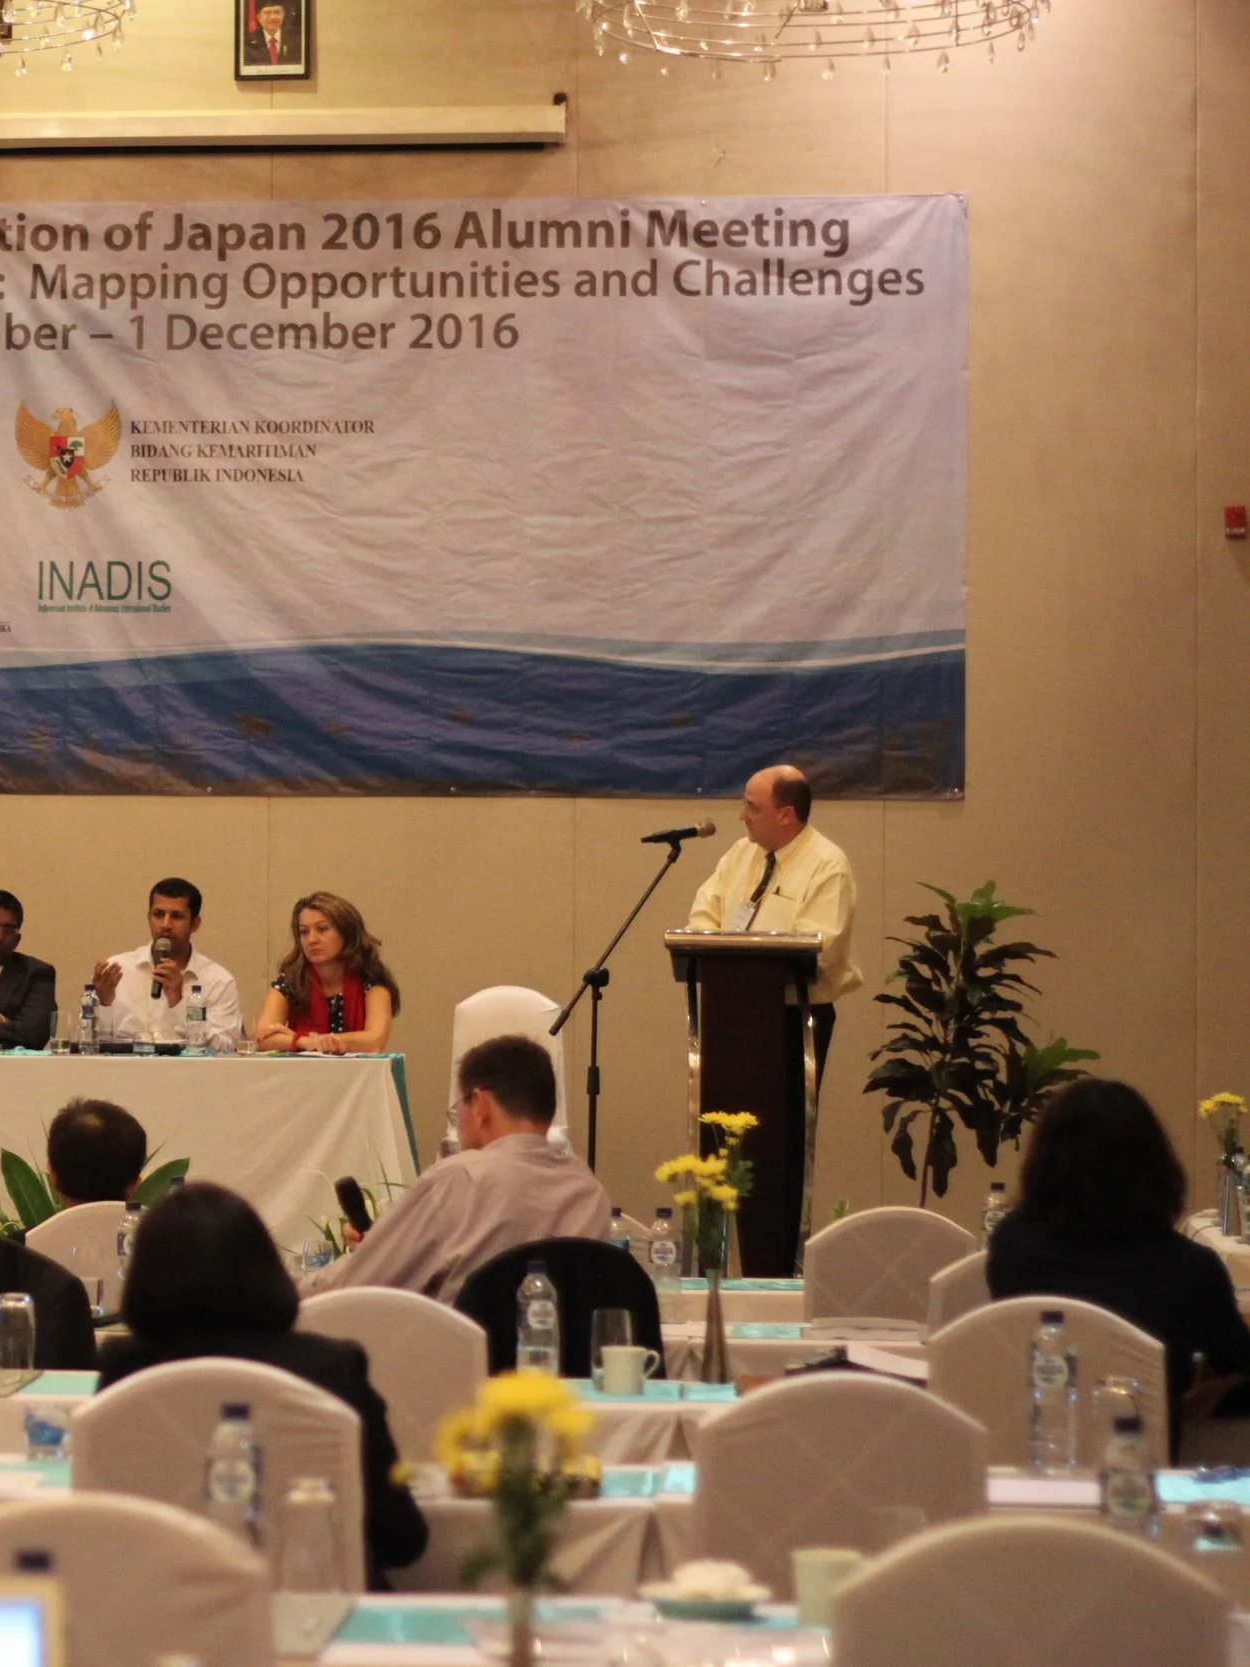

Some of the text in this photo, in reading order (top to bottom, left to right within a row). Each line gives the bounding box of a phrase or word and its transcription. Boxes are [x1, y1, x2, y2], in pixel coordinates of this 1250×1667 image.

[103, 211, 153, 251] of
[164, 213, 305, 261] Japan
[322, 212, 441, 250] 2016
[454, 209, 631, 249] Alumni
[646, 208, 849, 258] Meeting
[30, 263, 227, 309] Mapping
[243, 261, 560, 308] Opportunities
[574, 258, 657, 297] and
[673, 256, 925, 306] Challenges
[128, 314, 147, 351] 1
[166, 310, 396, 350] December
[410, 313, 519, 349] 2016
[130, 420, 375, 434] KEMENTERIAN KOORDINATOR
[130, 444, 317, 458] BIDANG KEMARITIMAN
[130, 468, 304, 483] REPUBLIK INDONESIA
[38, 560, 172, 601] INADIS
